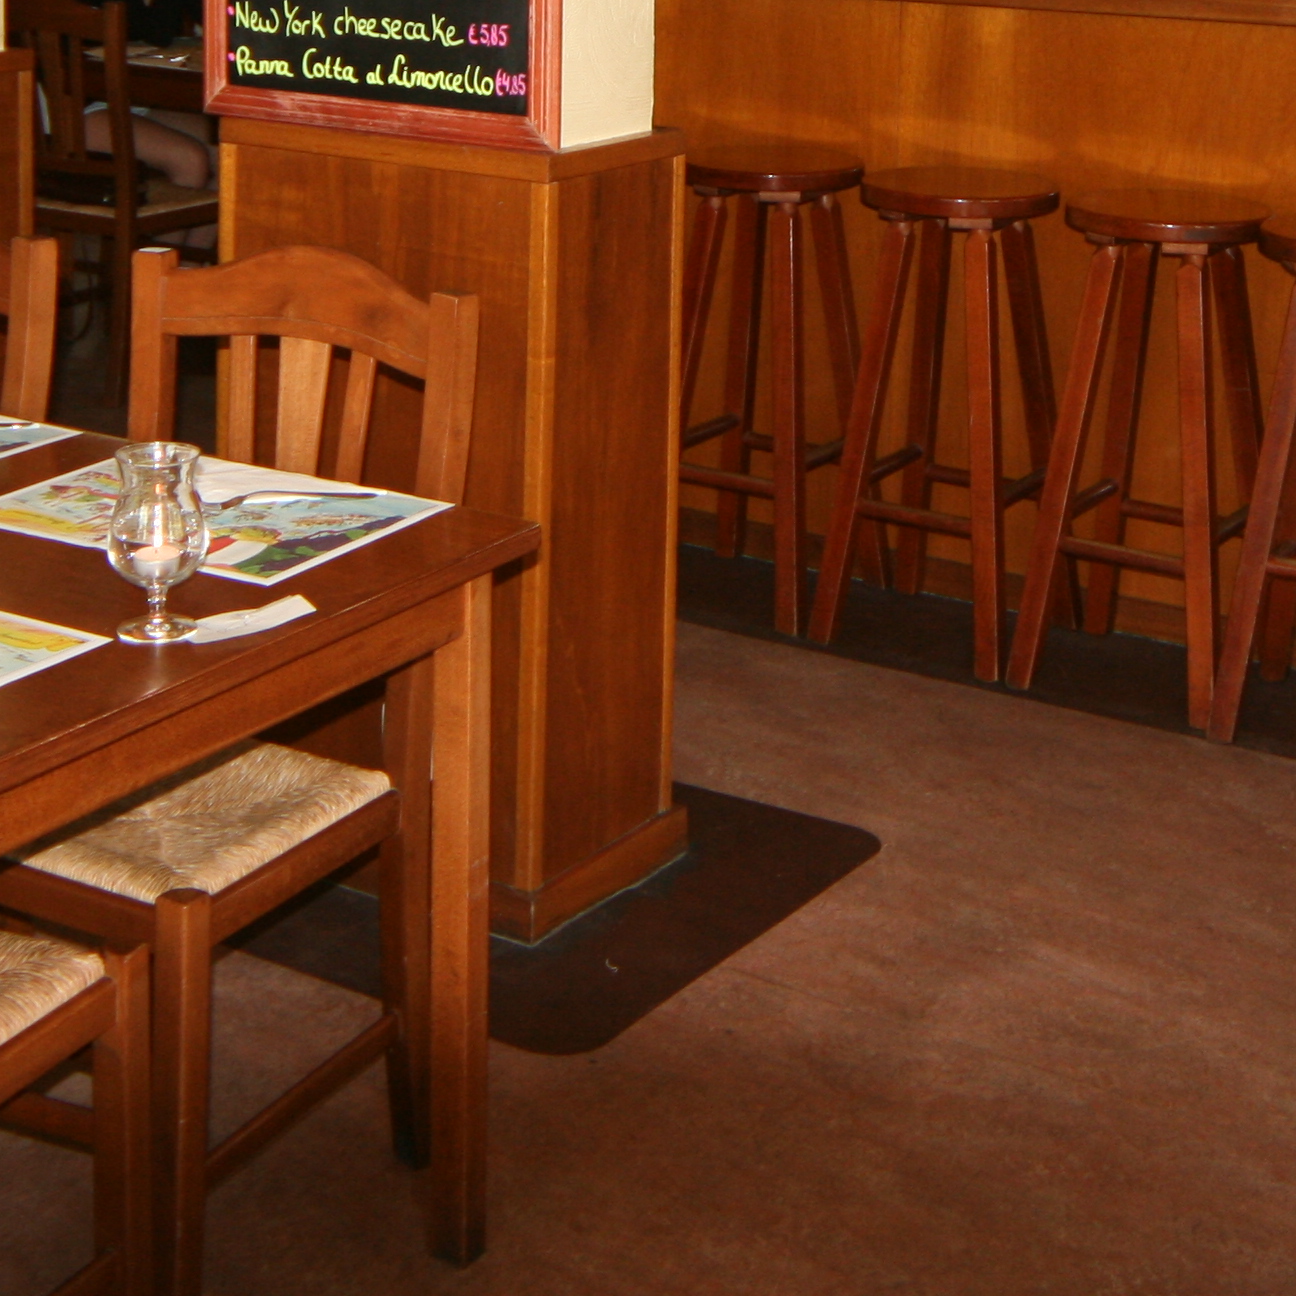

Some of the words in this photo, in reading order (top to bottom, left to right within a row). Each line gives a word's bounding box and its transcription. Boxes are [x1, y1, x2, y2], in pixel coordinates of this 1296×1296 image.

[235, 0, 280, 34] New
[235, 45, 294, 77] Panna
[301, 47, 359, 84] Cotta
[365, 64, 384, 85] al
[387, 54, 494, 96] Limoncello
